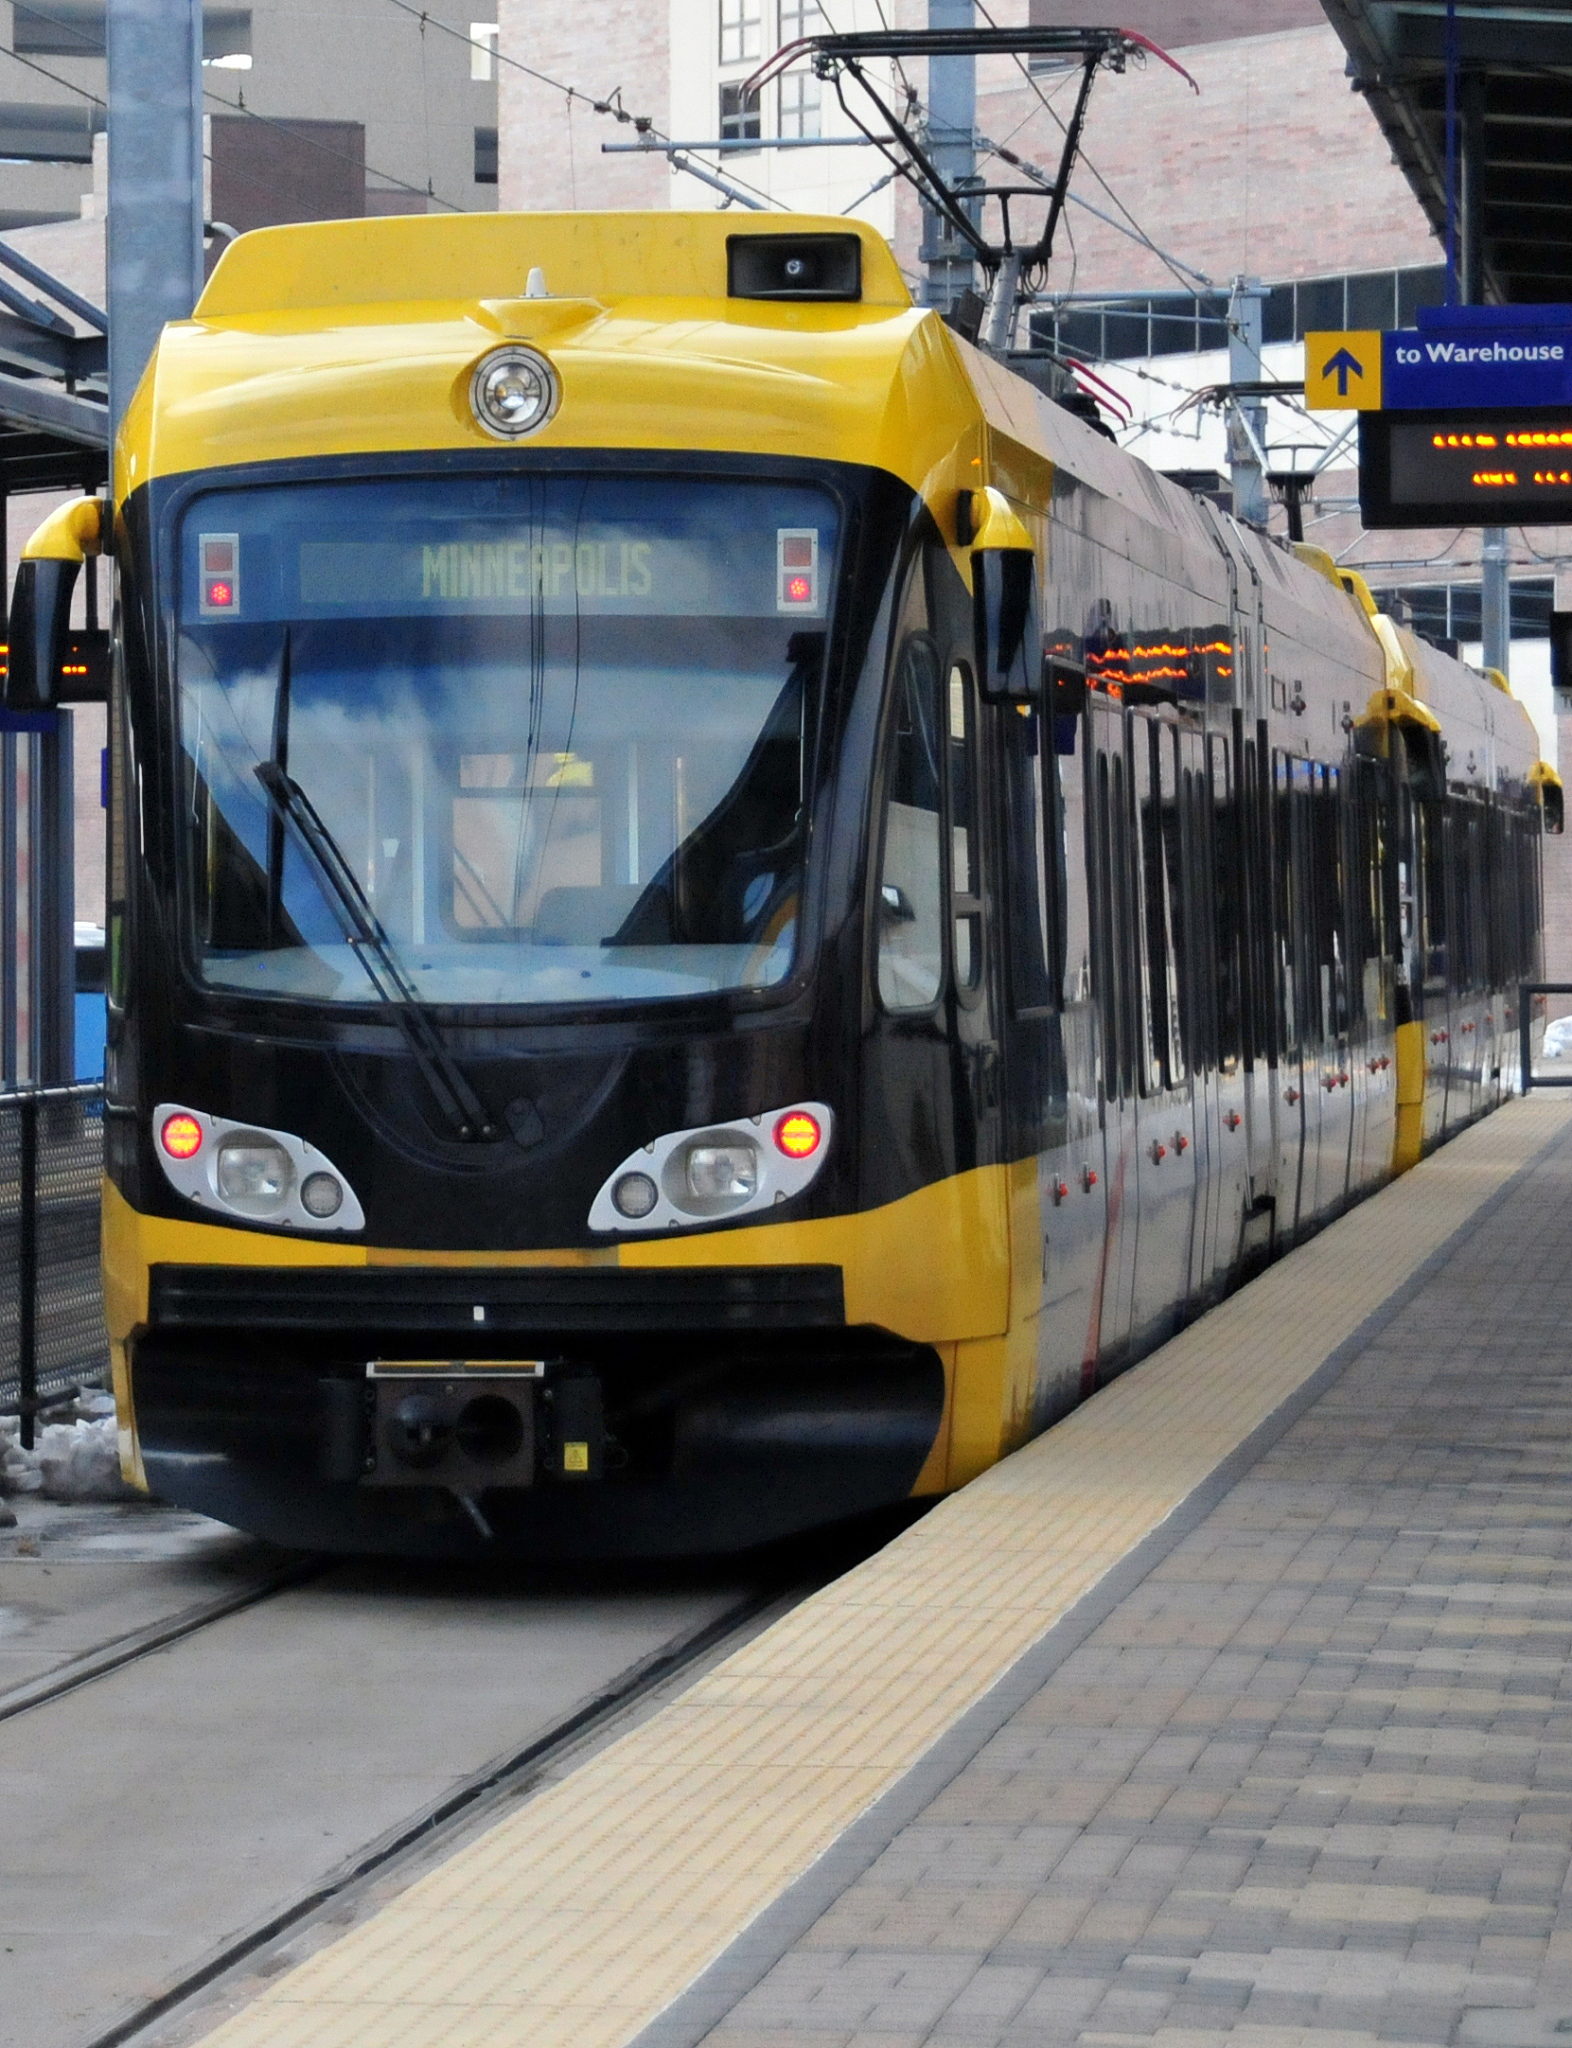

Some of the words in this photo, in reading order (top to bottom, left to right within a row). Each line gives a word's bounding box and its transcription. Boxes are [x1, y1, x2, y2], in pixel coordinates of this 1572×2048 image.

[1396, 346, 1421, 364] to
[1425, 342, 1564, 363] Warehouse
[421, 542, 653, 598] MINNEAPOLIS
